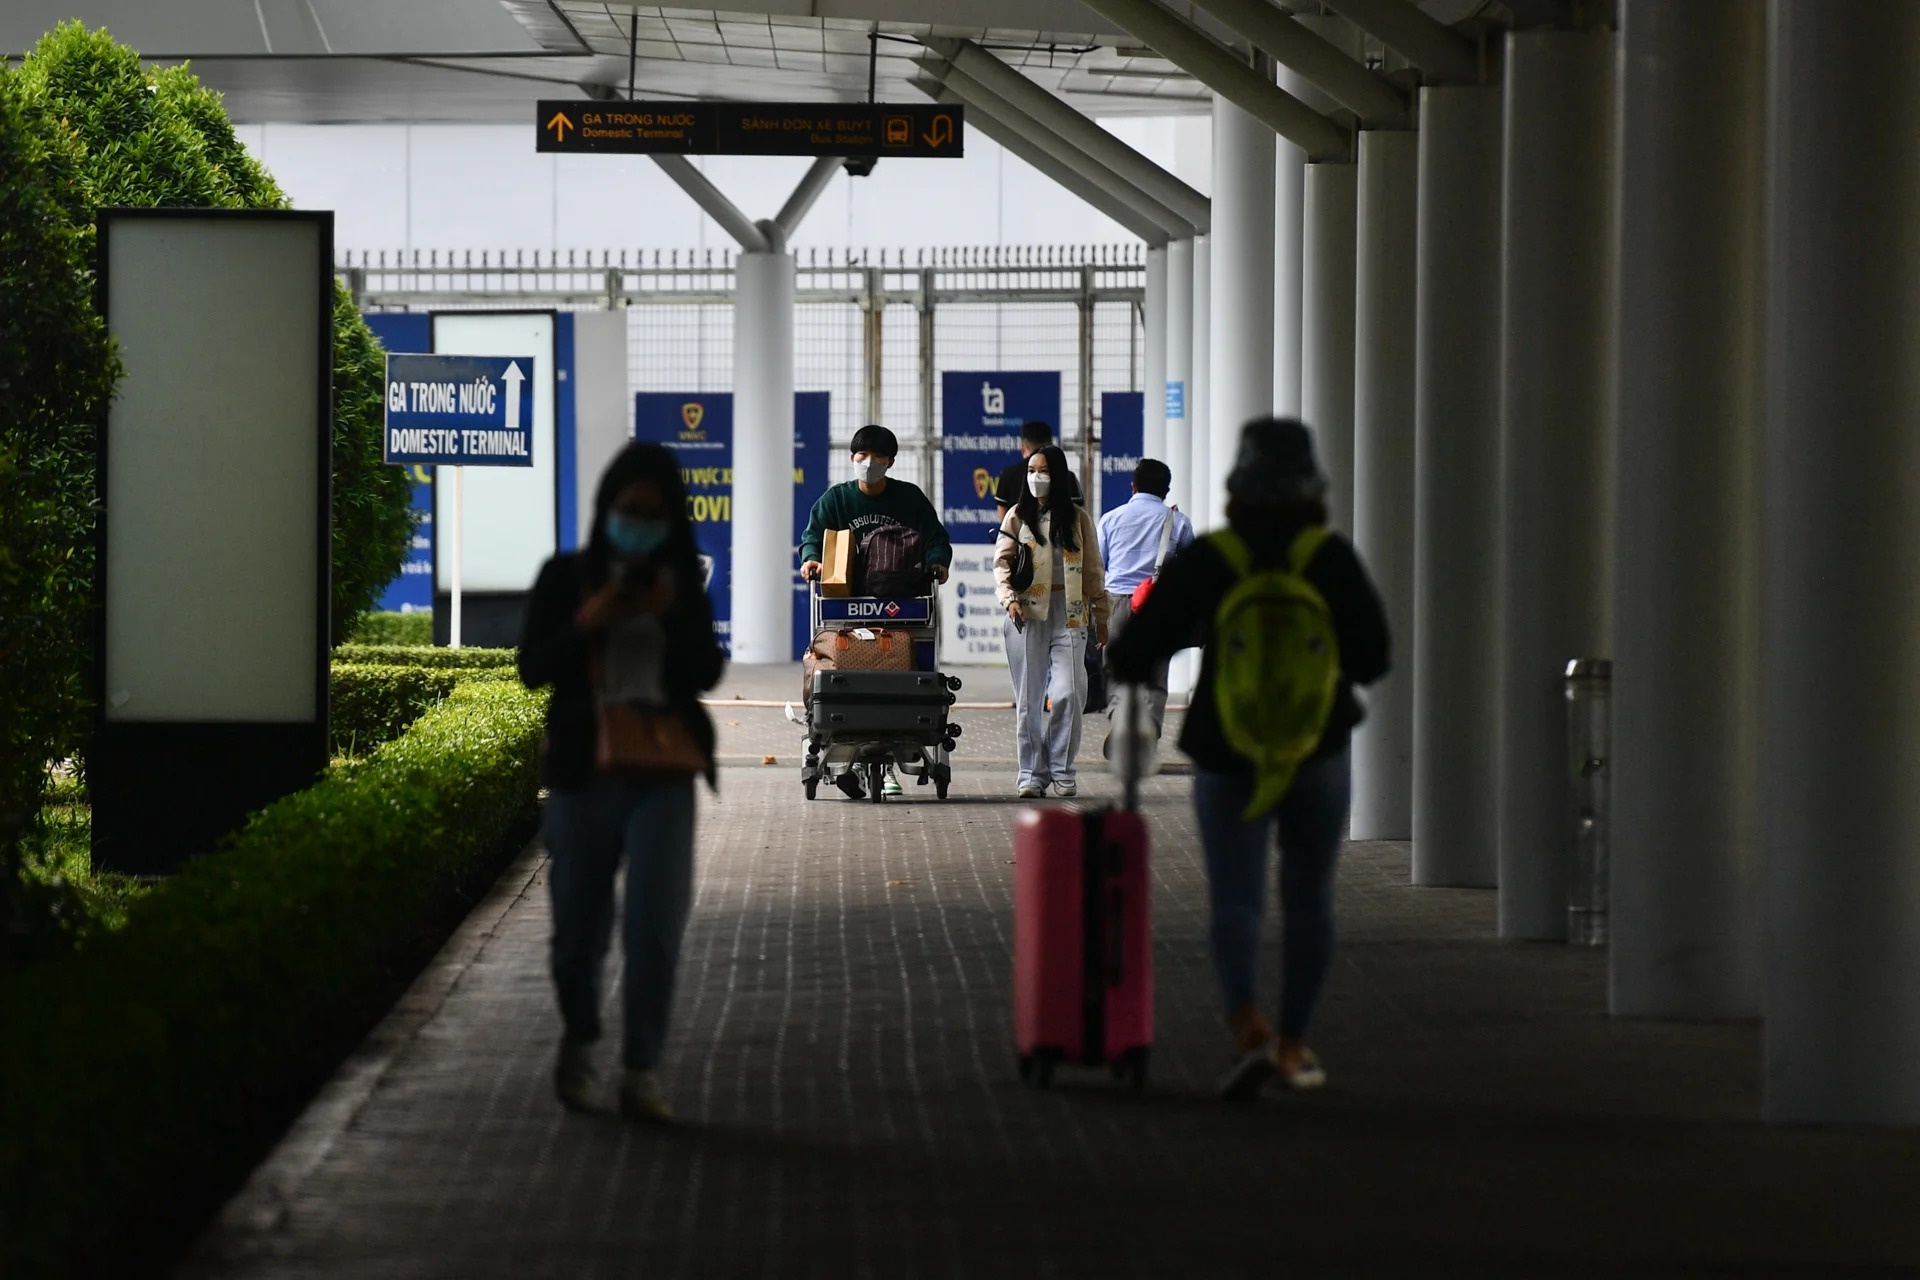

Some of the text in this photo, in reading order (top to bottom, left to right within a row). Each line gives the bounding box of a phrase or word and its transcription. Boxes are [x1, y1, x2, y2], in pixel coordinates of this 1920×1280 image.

[582, 113, 602, 125] GA
[605, 113, 653, 126] TRONG
[582, 127, 684, 140] Domestic Terminal
[389, 375, 497, 415] GA TRONG NƯỚC
[390, 428, 528, 456] DOMESTIC TERMINAL
[847, 602, 884, 616] BIDV
